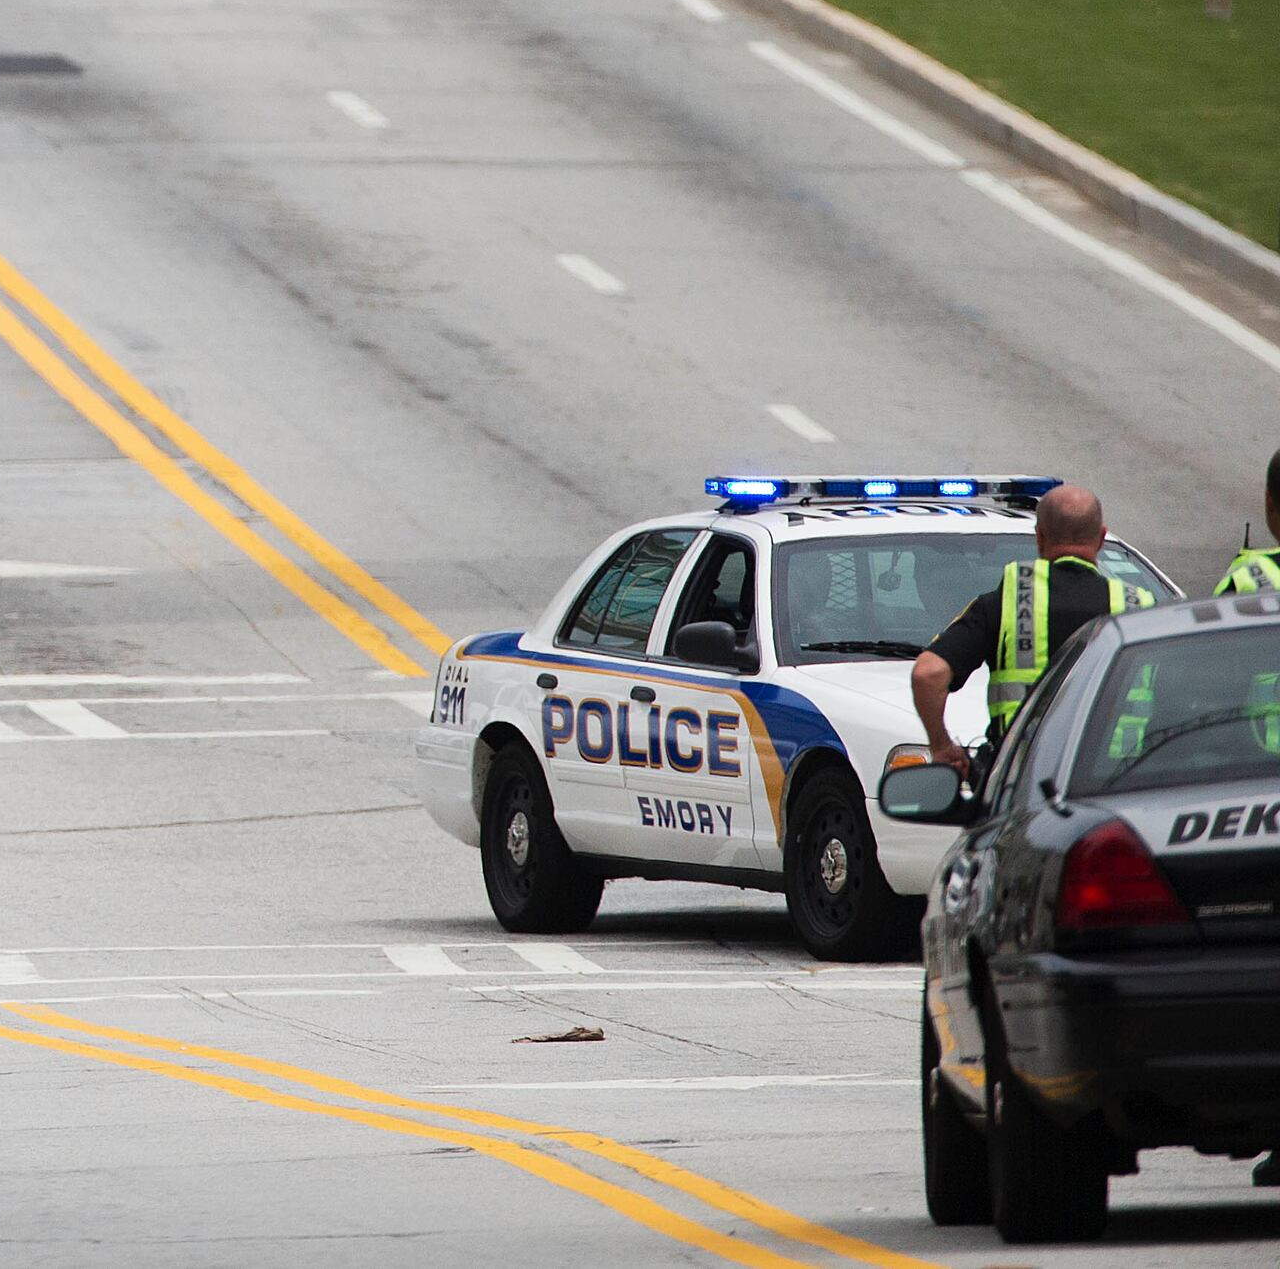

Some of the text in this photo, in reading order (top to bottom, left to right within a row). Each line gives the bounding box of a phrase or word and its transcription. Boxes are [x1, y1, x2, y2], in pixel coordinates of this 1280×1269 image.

[1018, 565, 1033, 652] DEKALB
[445, 665, 470, 684] DIAL
[440, 684, 466, 726] 911
[541, 693, 743, 778] POLICE
[637, 796, 732, 837] EMORY
